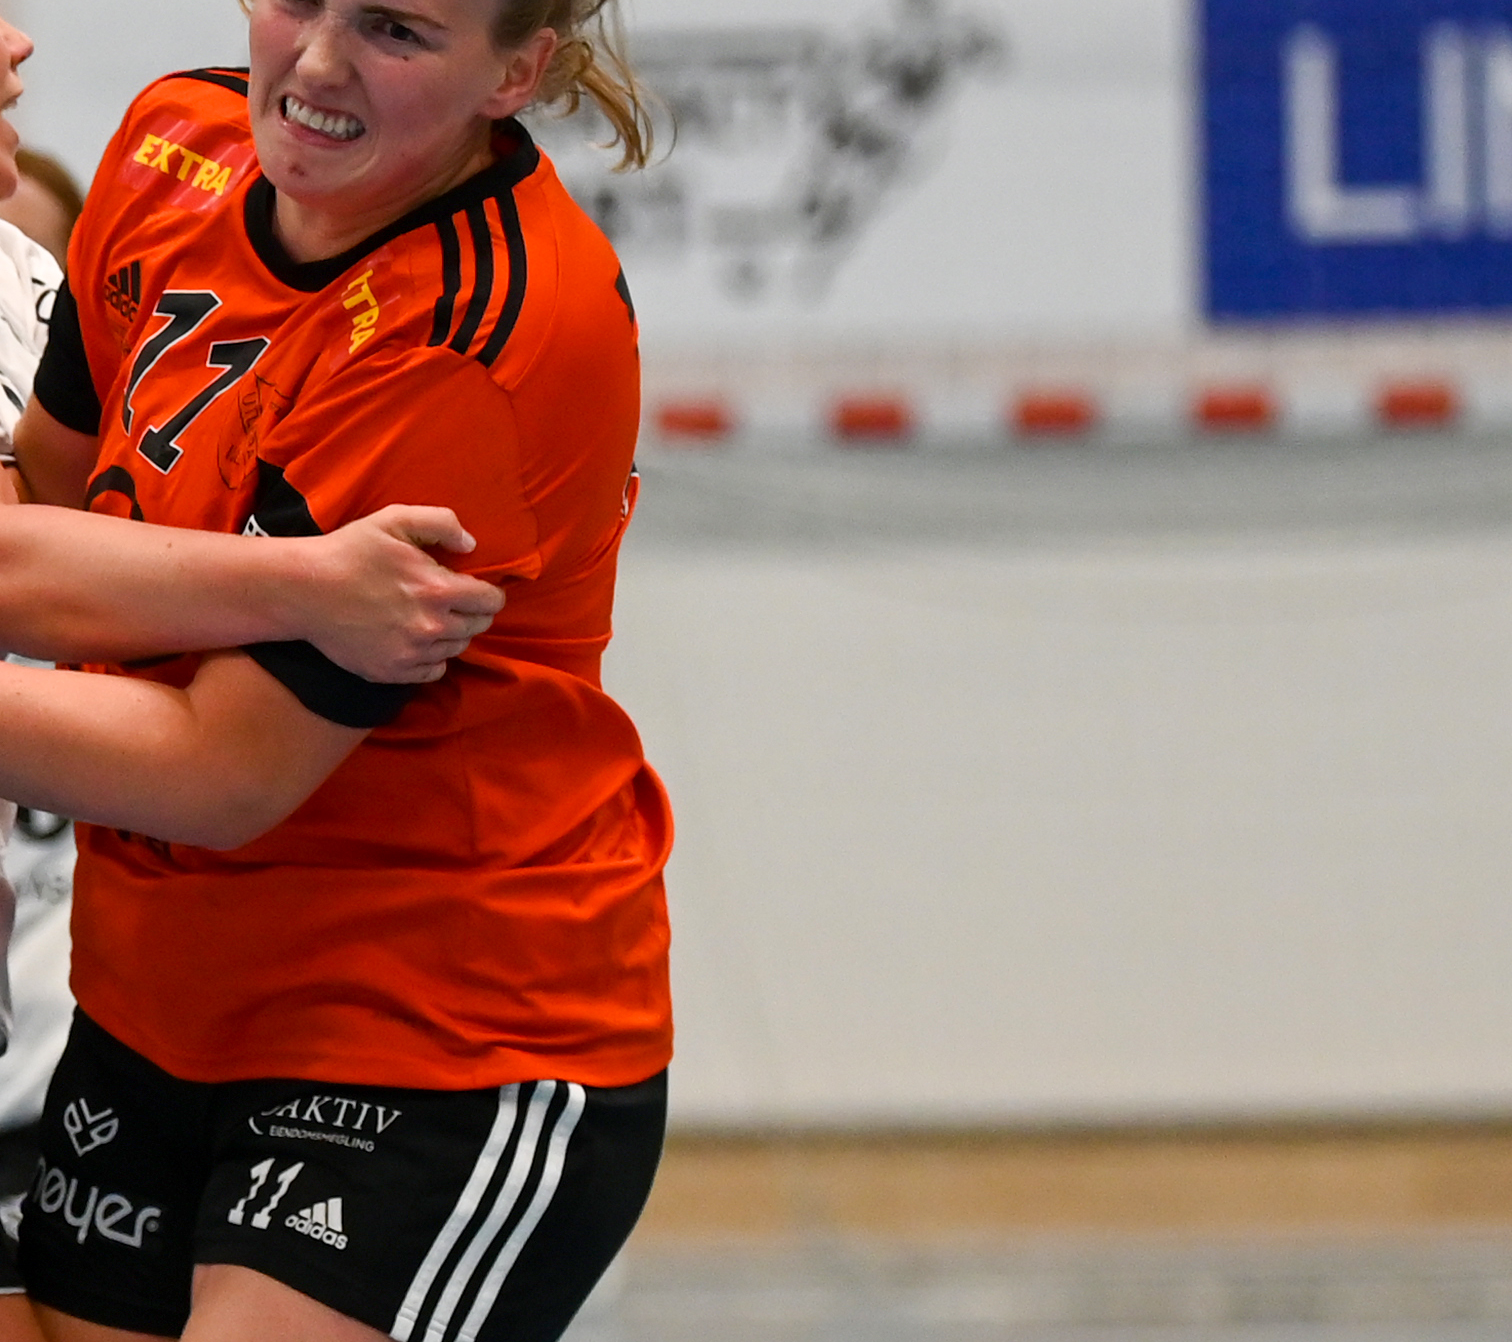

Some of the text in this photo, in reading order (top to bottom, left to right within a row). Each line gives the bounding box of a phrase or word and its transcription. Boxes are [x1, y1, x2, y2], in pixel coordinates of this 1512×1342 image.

[133, 133, 233, 196] EXTRA
[228, 1157, 306, 1231] 11
[283, 1214, 349, 1251] adidas
